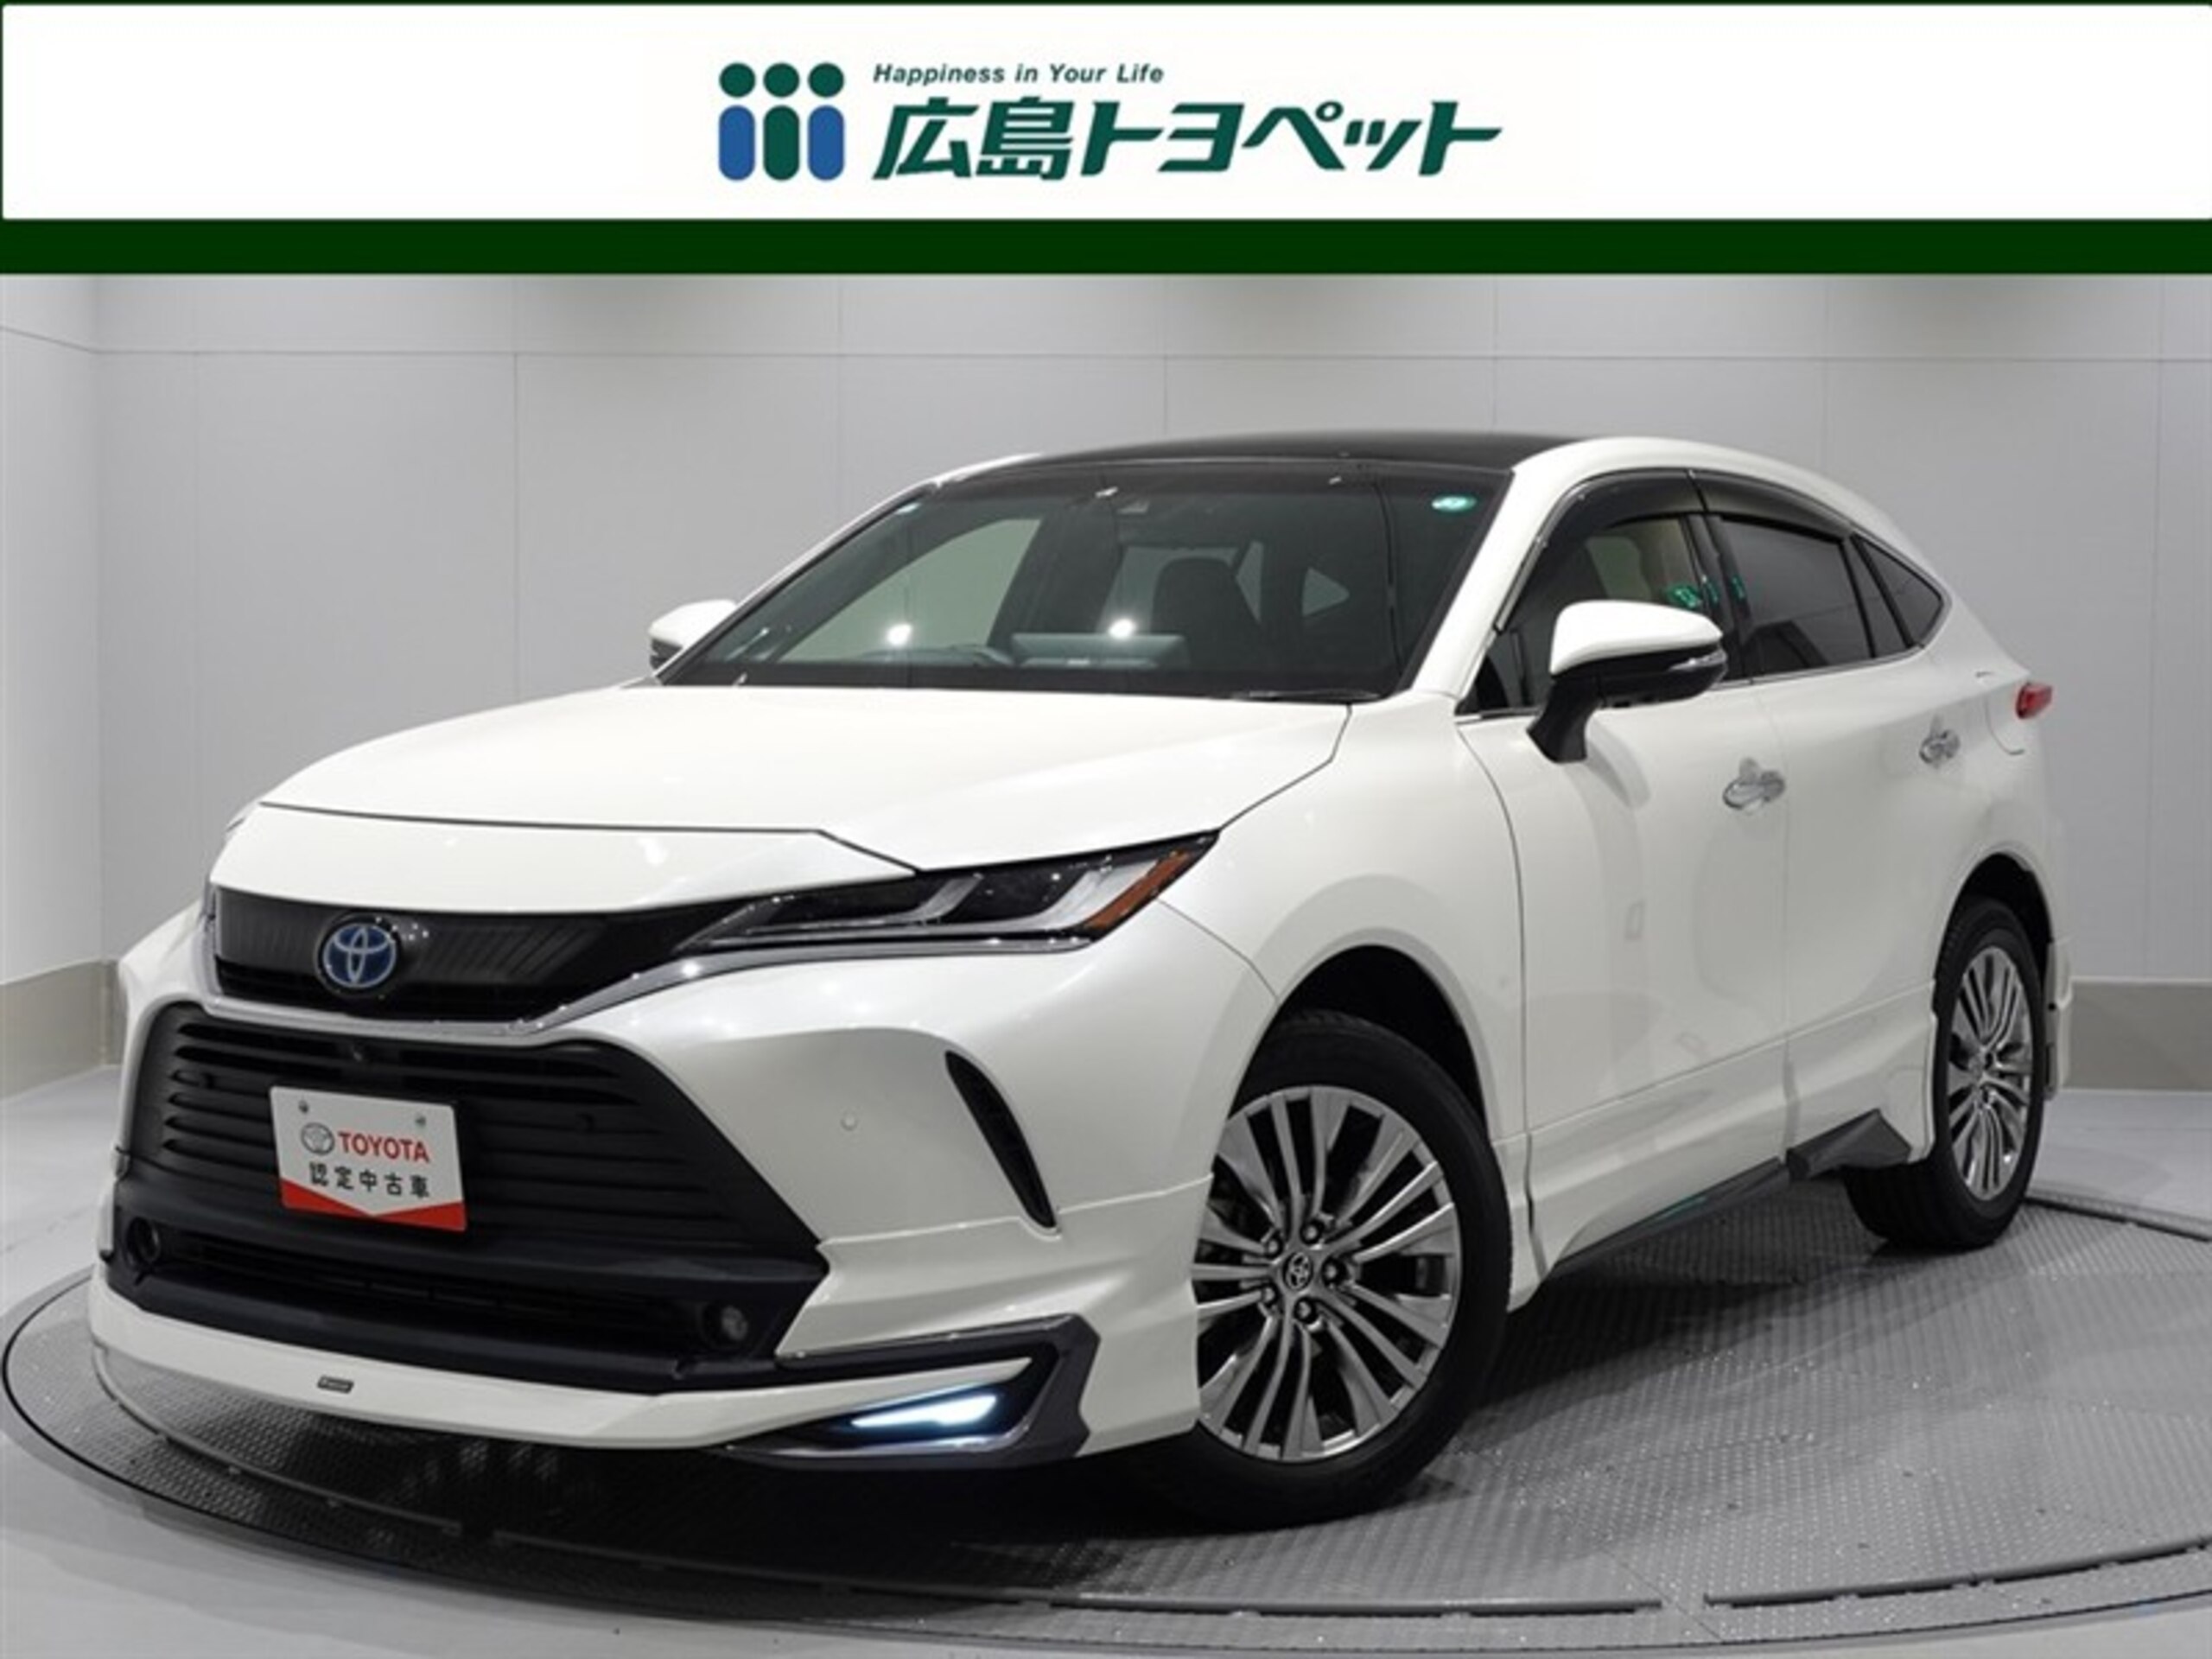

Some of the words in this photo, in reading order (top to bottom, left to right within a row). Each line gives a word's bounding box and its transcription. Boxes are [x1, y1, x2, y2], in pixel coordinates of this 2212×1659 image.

[337, 1131, 430, 1163] TOYOTA
[308, 1161, 429, 1198] 認定中古車
